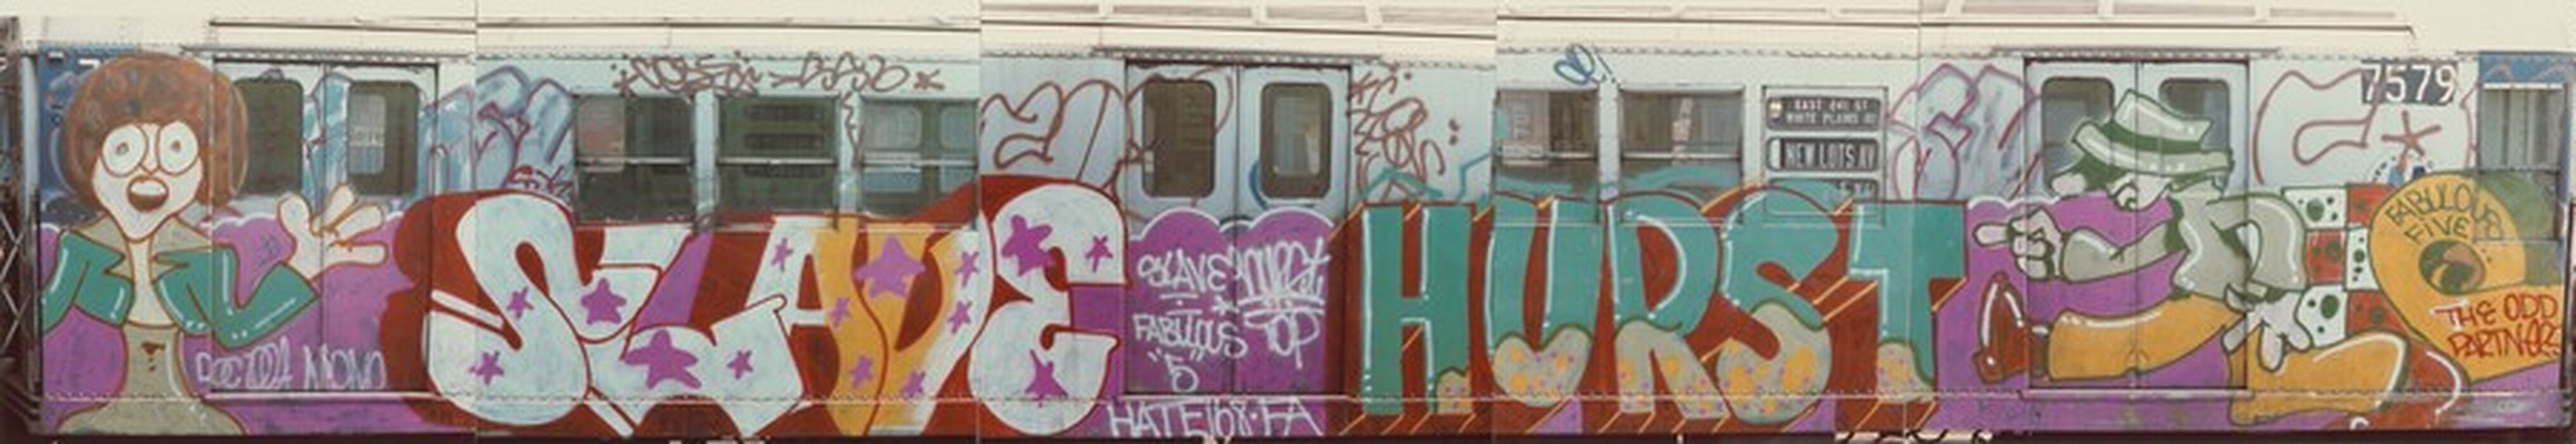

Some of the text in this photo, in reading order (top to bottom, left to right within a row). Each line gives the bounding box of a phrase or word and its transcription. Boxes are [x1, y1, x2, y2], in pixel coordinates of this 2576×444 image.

[2360, 64, 2457, 103] 7579
[1794, 100, 1822, 111] EAST
[1786, 143, 1876, 169] NEW LOTS AV
[1137, 248, 1231, 292] SLAVE
[422, 184, 1968, 438] SLAVE HURST
[2430, 292, 2559, 330] THE ODD
